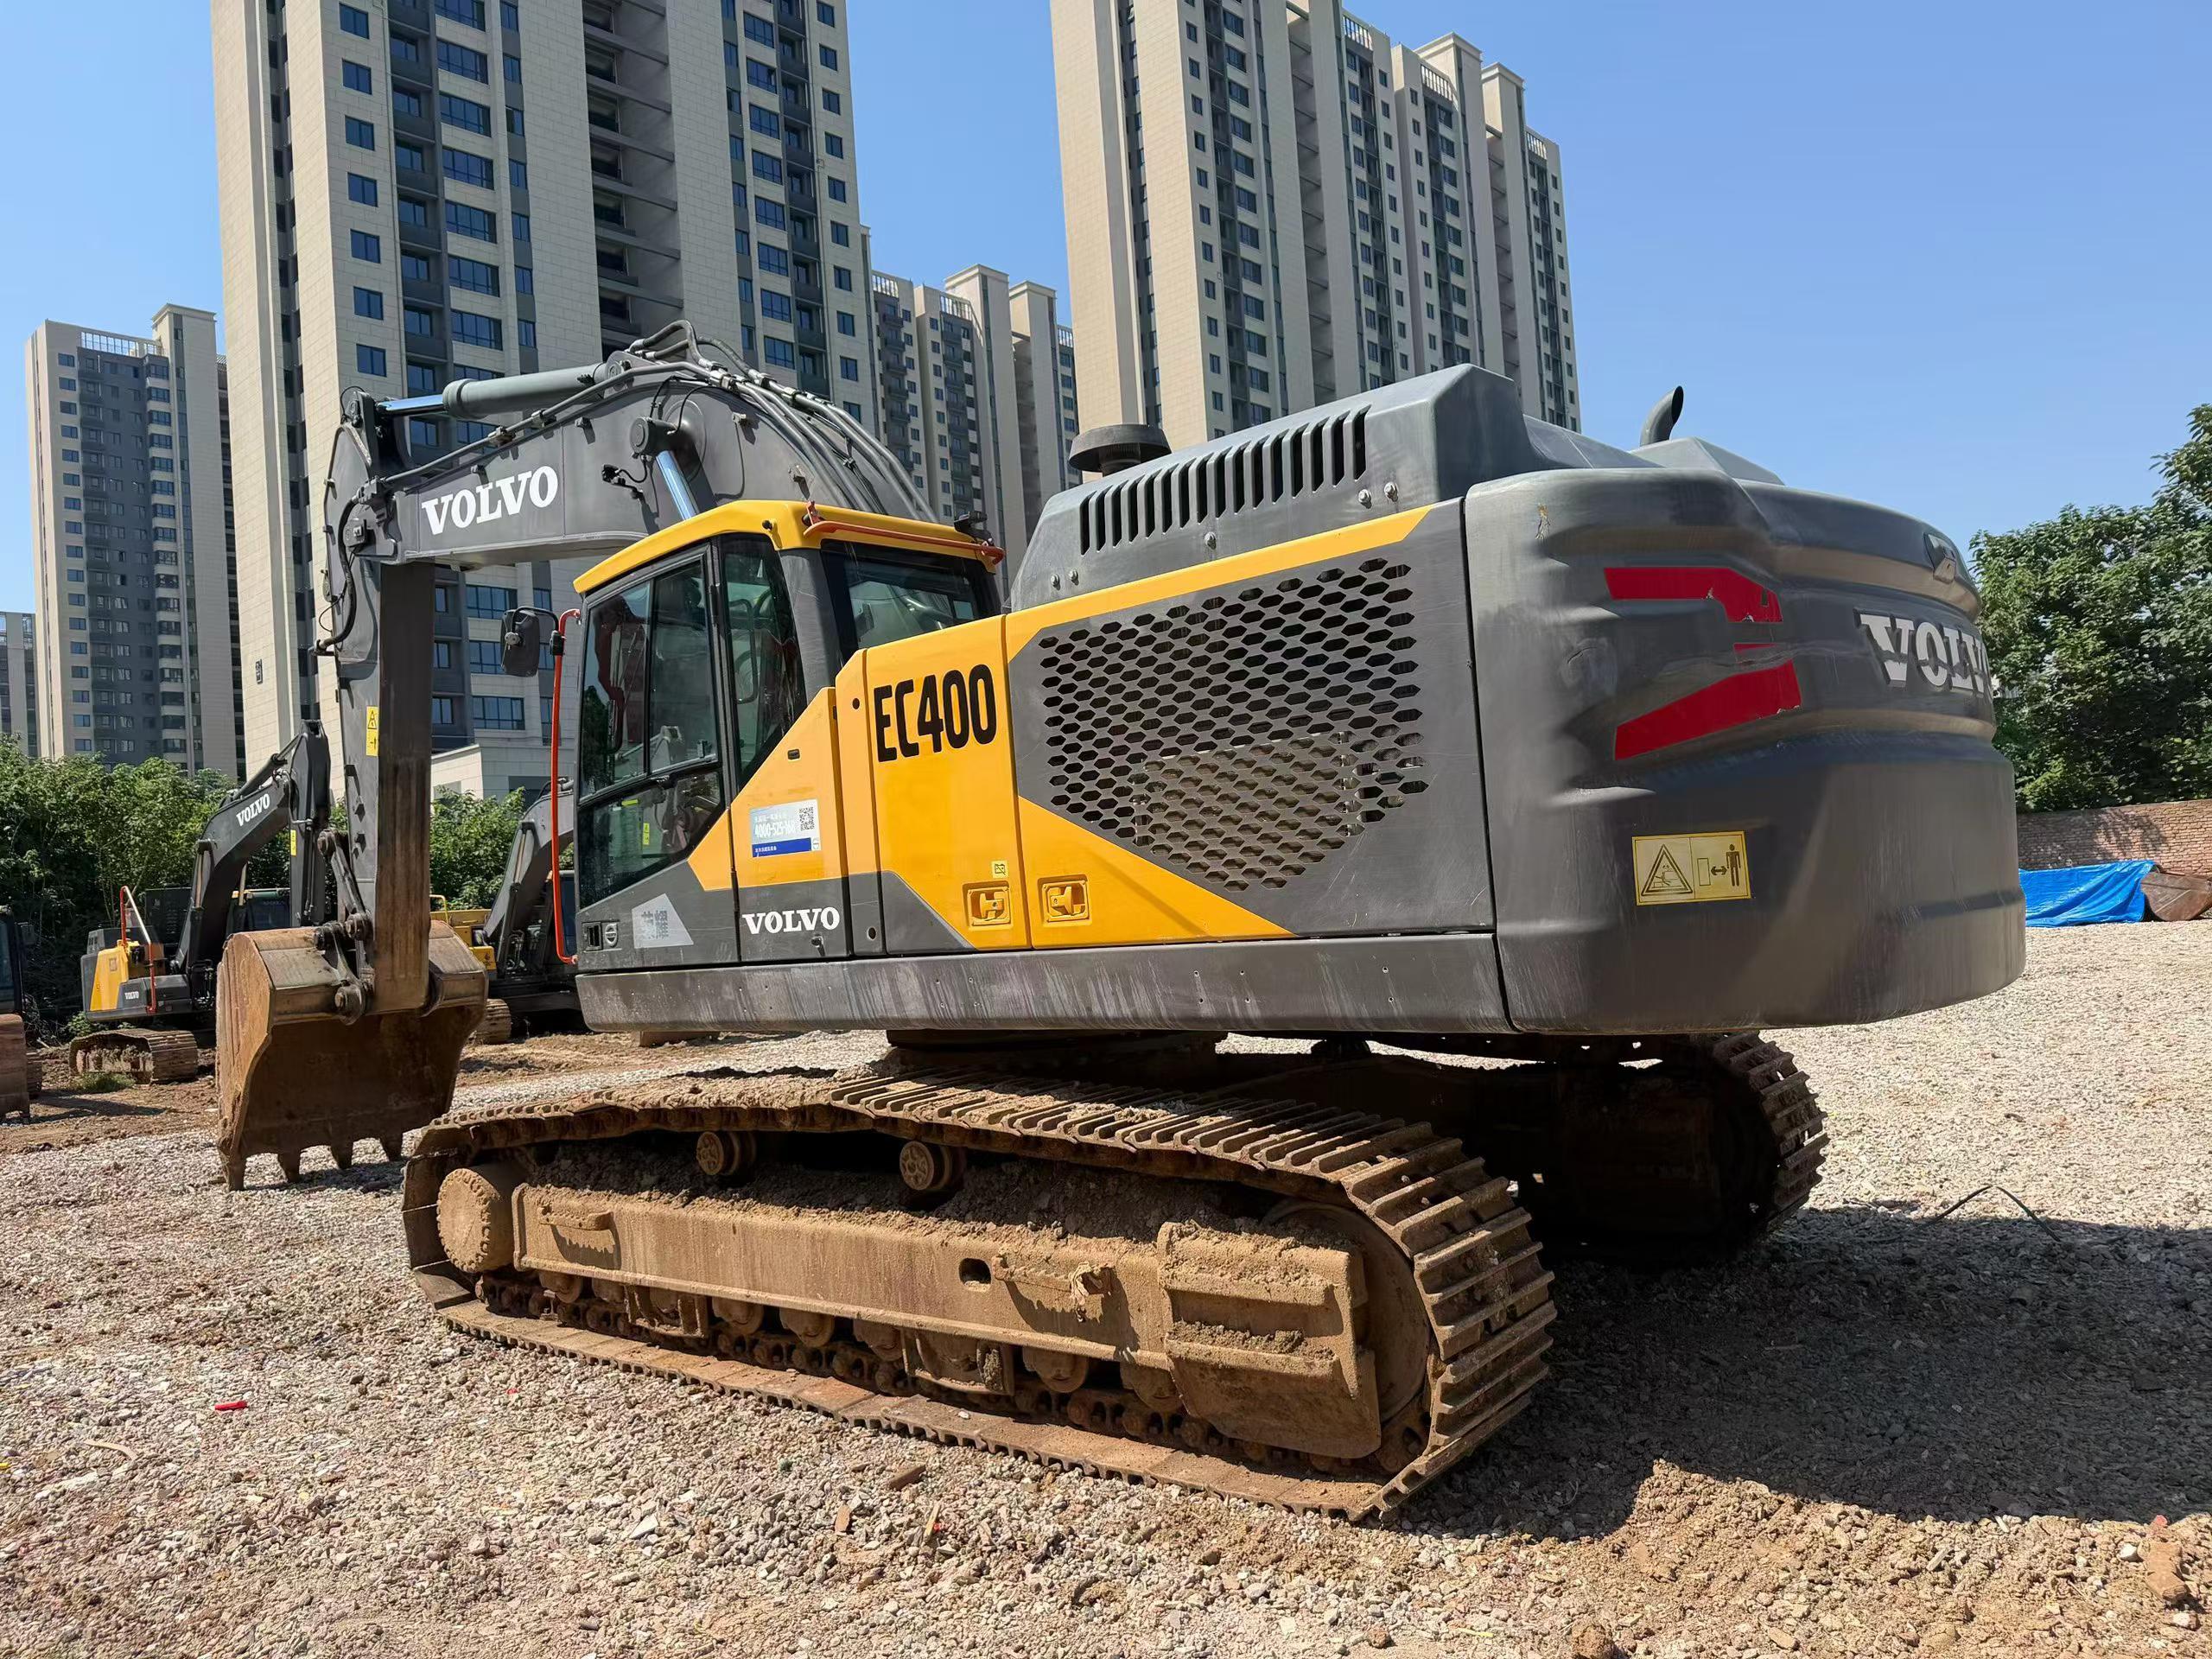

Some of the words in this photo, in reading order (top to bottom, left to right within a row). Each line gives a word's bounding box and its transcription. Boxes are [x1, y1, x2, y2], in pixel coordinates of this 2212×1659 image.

[422, 466, 558, 535] VOLVO
[874, 664, 996, 762] EC400
[236, 793, 270, 827] VOLVO
[742, 906, 840, 934] VOLVO
